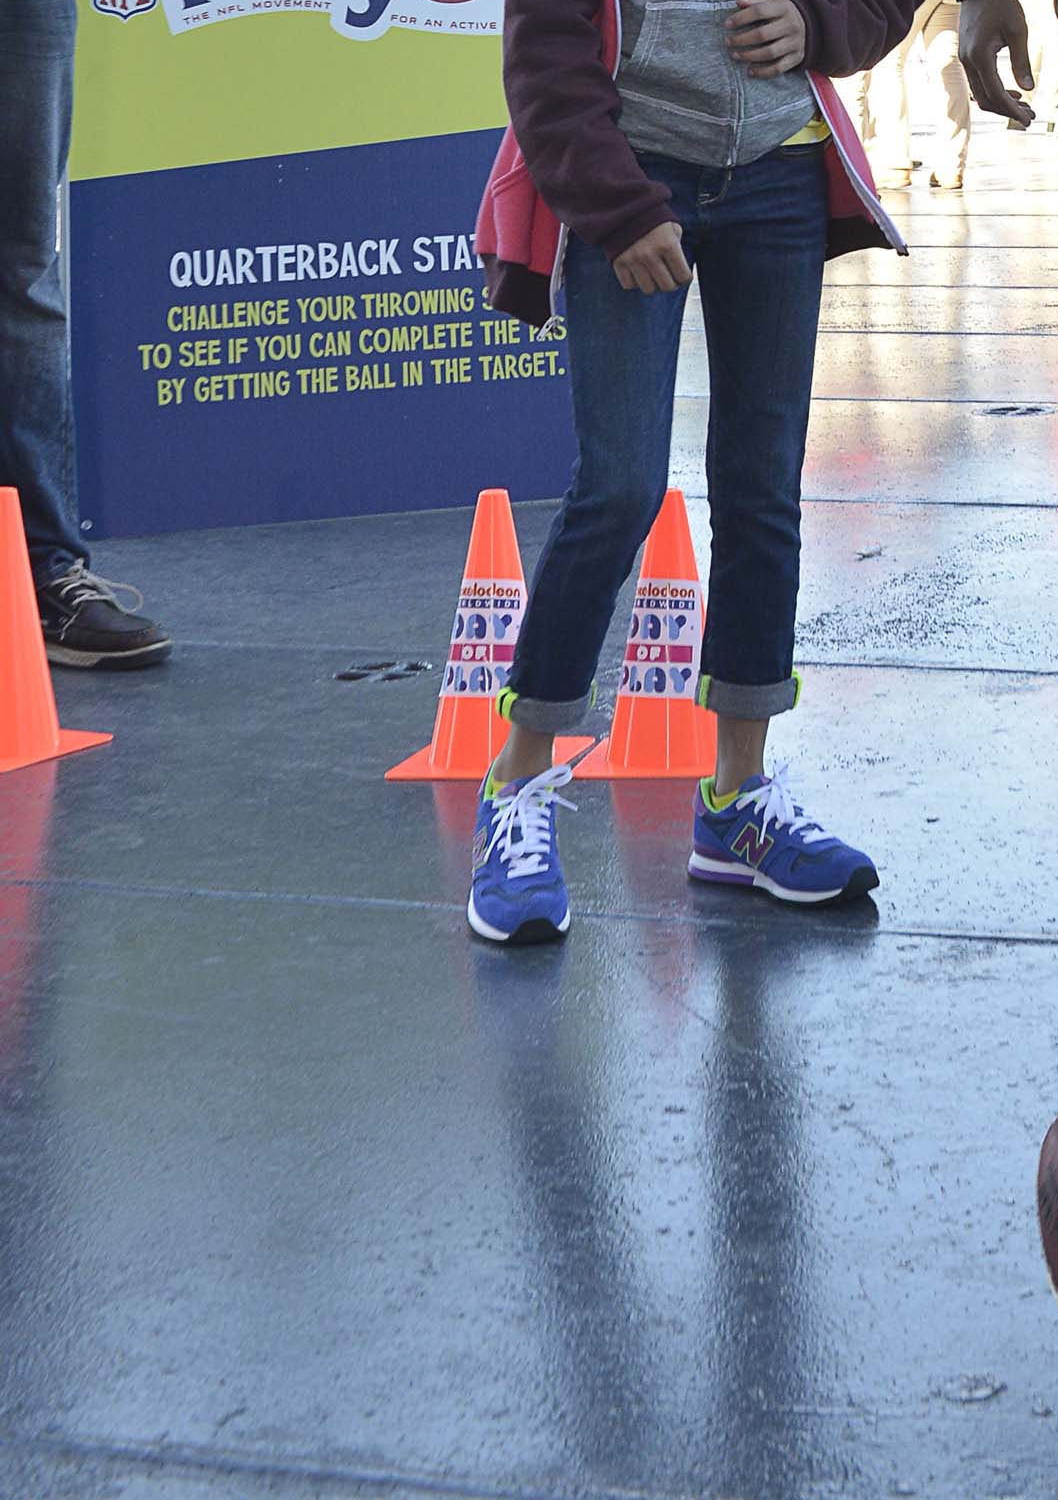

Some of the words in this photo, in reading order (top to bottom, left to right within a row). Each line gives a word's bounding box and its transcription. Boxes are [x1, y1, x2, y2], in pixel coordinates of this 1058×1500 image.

[182, 11, 210, 25] THE
[217, 5, 245, 17] NFL
[252, 0, 332, 10] MOVEMENT
[390, 14, 417, 25] FOR
[424, 19, 443, 27] AN
[450, 21, 497, 30] ACTIVE
[169, 238, 402, 288] QUARTERBACK
[167, 299, 290, 333] CHALLENGE
[296, 295, 357, 324] YOUR
[360, 287, 475, 319] THROWING
[137, 343, 172, 371] TO
[178, 339, 221, 368] SEE
[227, 337, 249, 364] IF
[255, 334, 301, 362] YOU
[309, 331, 351, 358] CAN
[358, 322, 473, 355] COMPLETE
[480, 319, 521, 345] THE
[157, 377, 187, 406] BY
[193, 370, 291, 402] GETTING
[296, 367, 338, 394] THE
[345, 363, 396, 391] BALL
[402, 361, 423, 387] IN
[430, 357, 472, 384] THE
[478, 351, 566, 381] TARGET.
